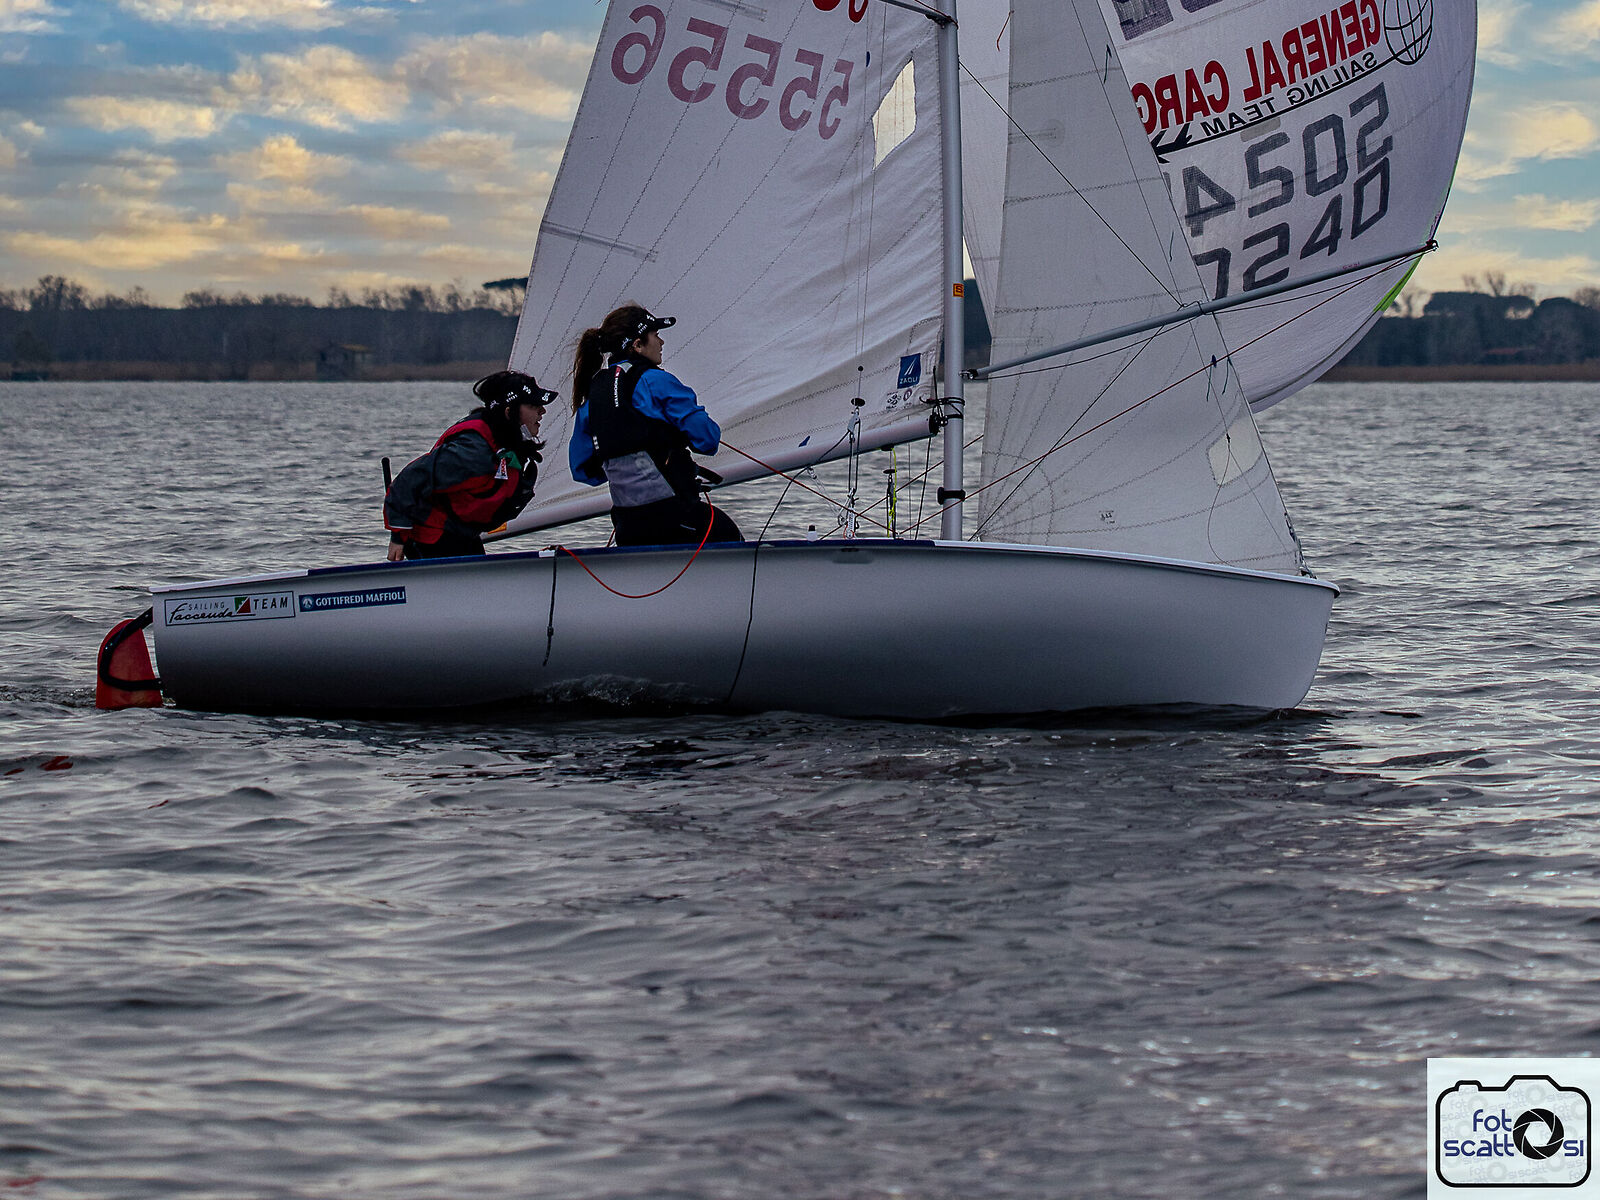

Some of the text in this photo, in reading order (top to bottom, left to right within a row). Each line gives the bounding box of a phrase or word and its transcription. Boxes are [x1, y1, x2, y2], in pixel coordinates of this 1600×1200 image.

[253, 597, 288, 610] TEAM
[315, 591, 406, 607] GOTTIFREDI MAFFIOLI
[188, 601, 225, 611] SAILING
